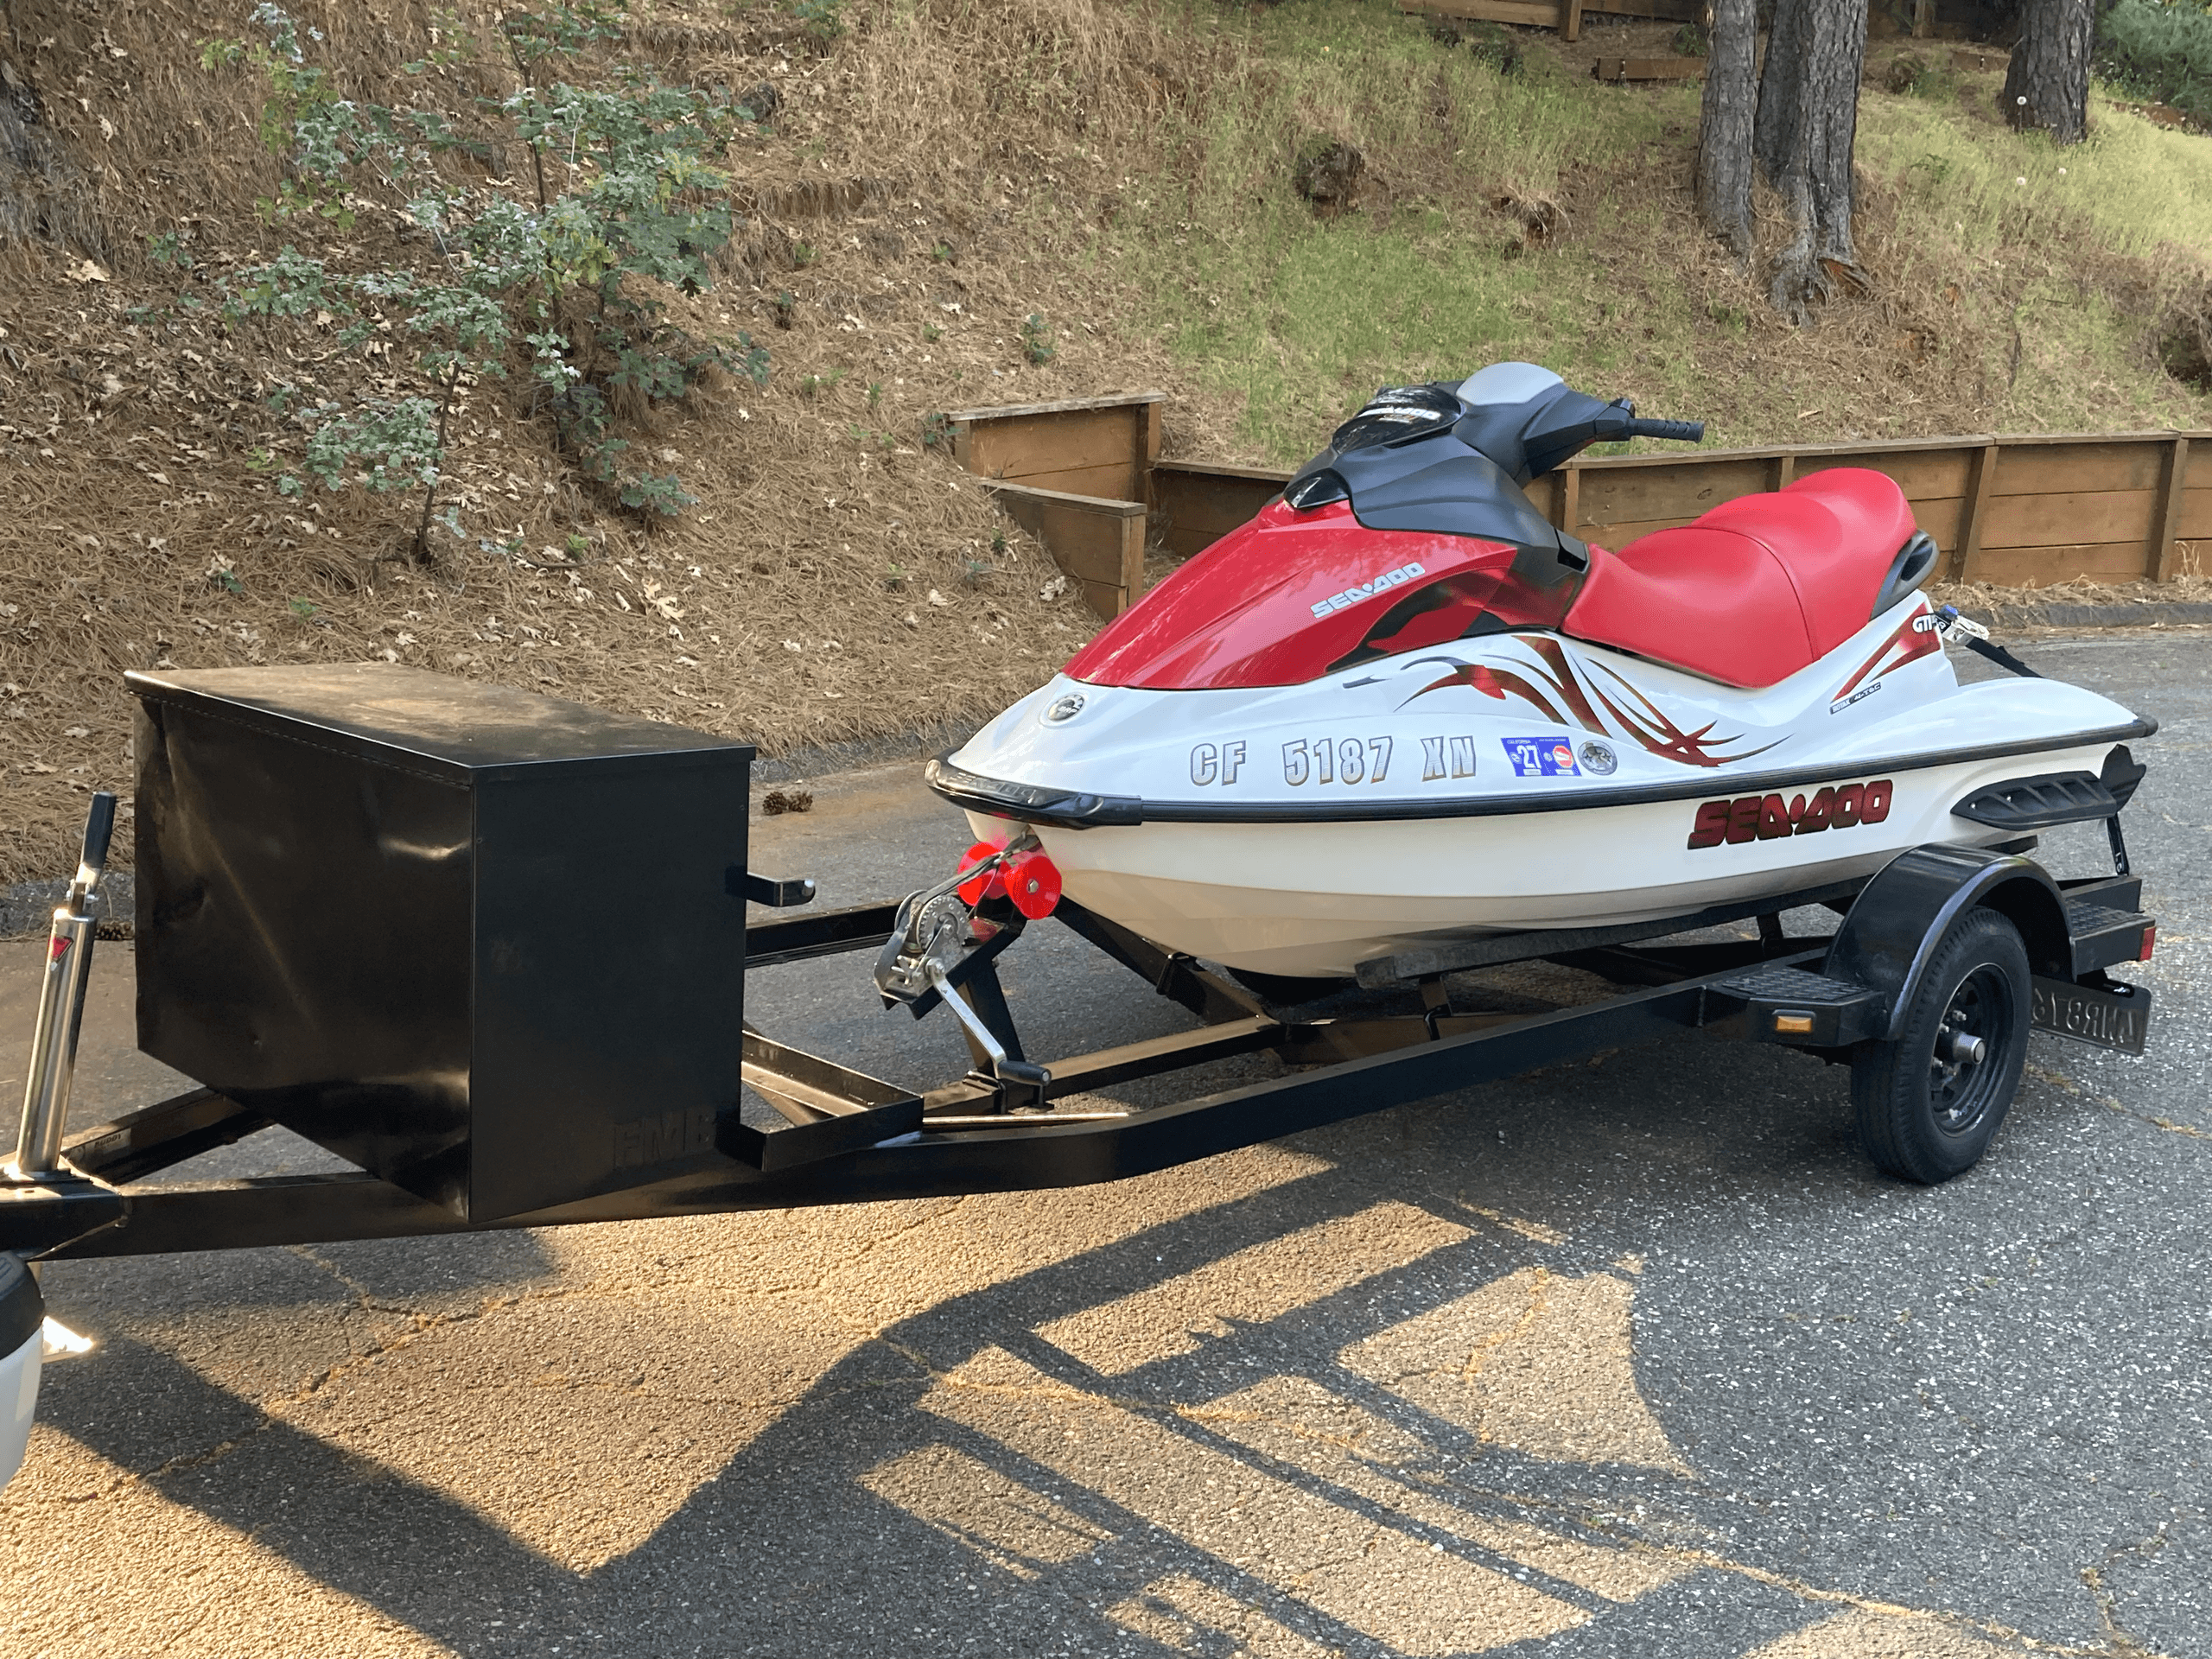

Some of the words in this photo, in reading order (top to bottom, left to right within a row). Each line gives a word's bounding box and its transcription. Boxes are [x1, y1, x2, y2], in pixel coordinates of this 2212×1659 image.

[1190, 740, 1246, 786] CF
[1281, 735, 1393, 786] 5187
[1420, 735, 1477, 782] XN
[1516, 745, 1541, 768] 27
